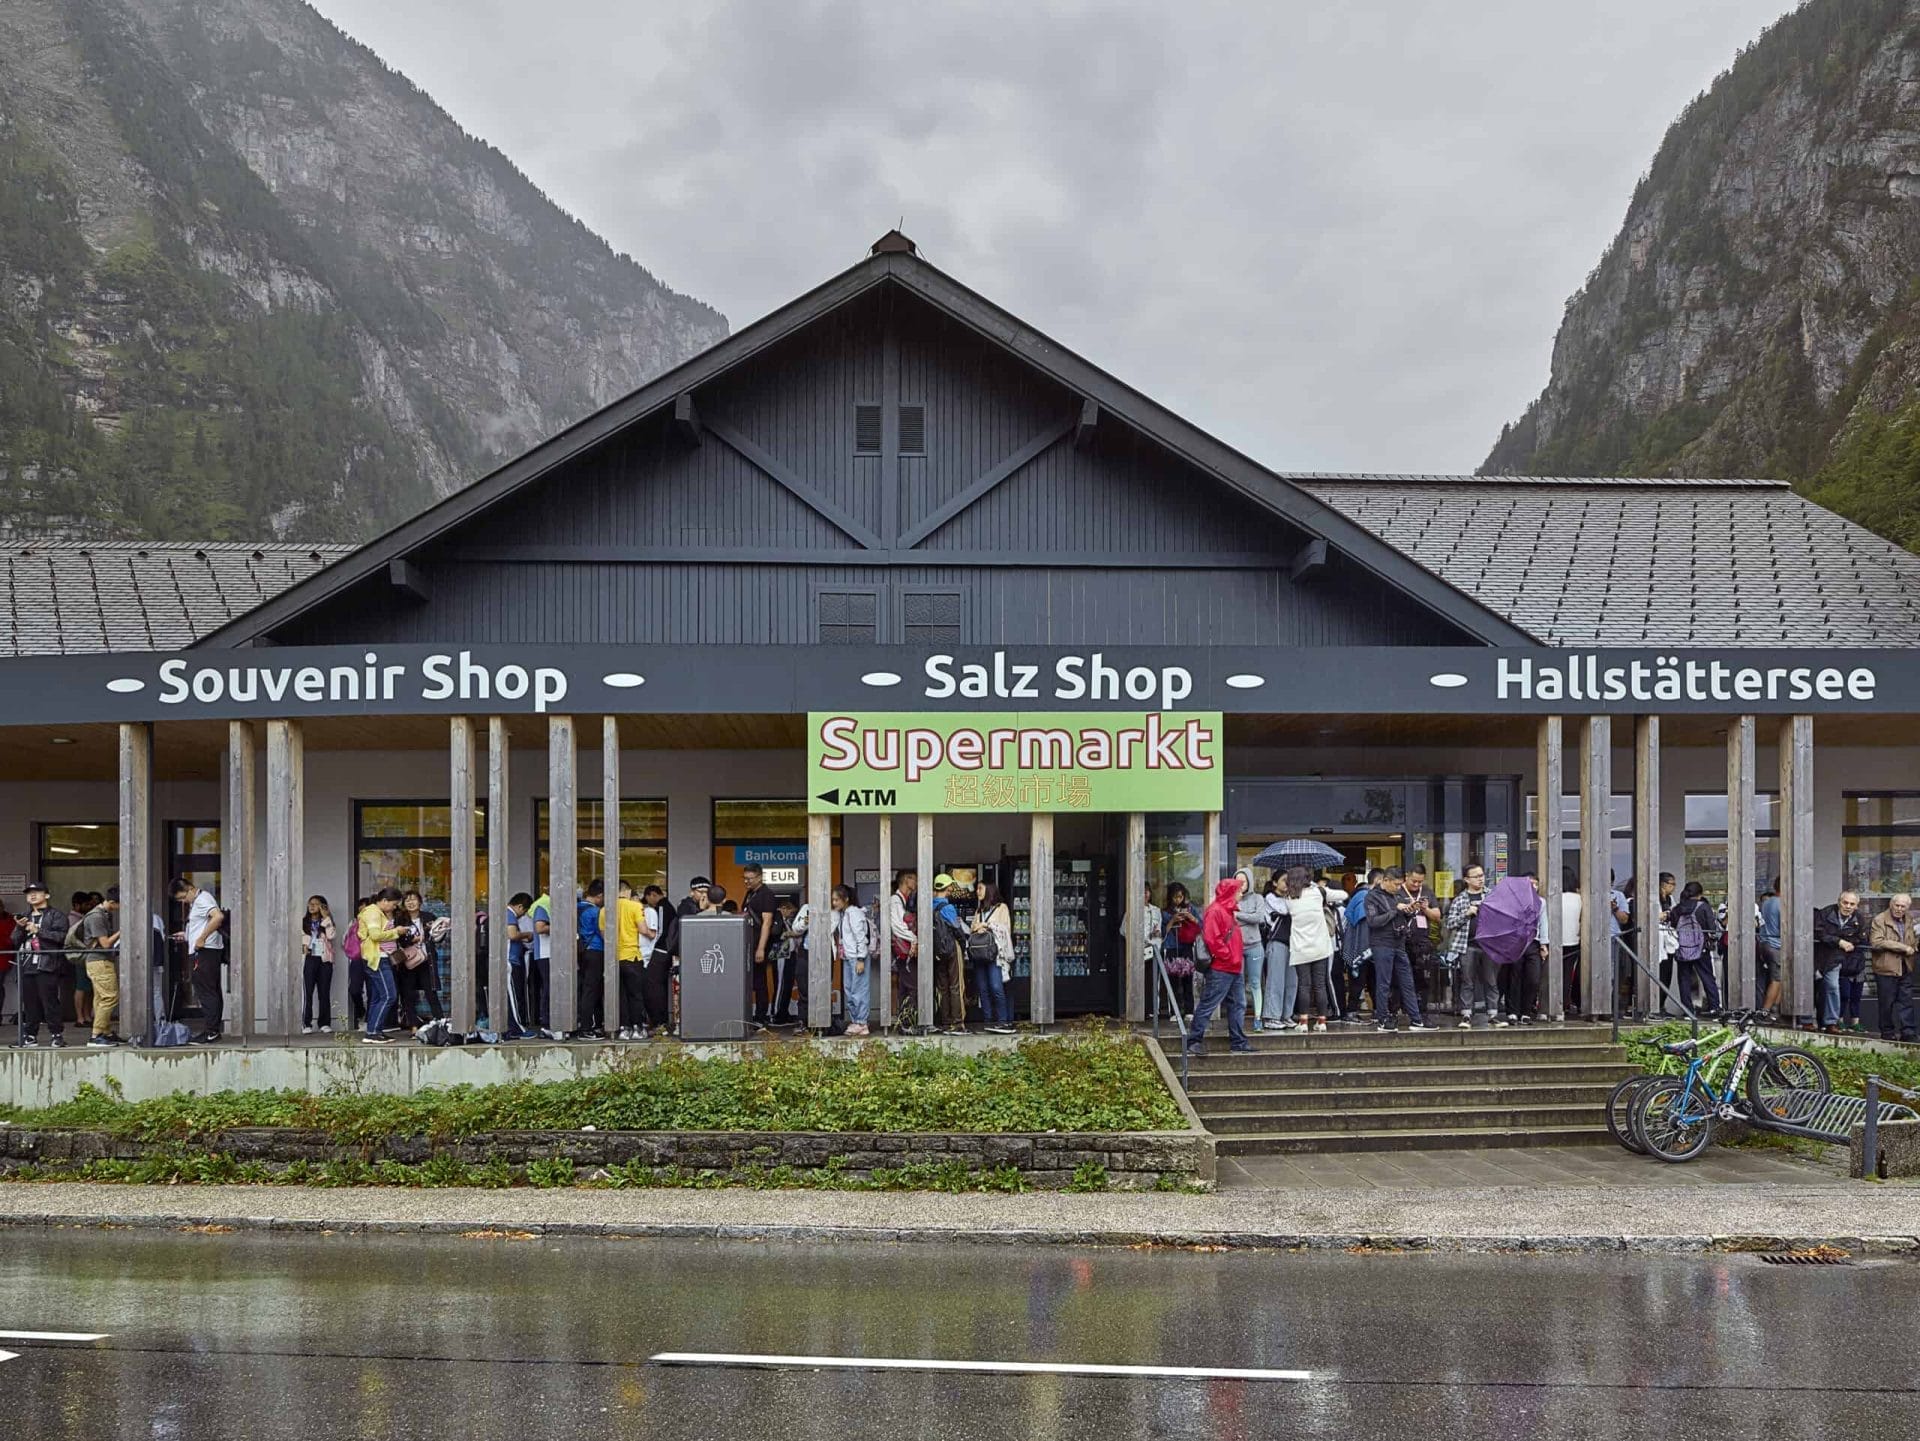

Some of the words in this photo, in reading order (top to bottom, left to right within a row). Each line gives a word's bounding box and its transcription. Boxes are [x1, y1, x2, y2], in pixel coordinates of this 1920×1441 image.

[158, 652, 405, 704] Souvenir
[421, 651, 568, 713] Shop
[924, 652, 1039, 699] Salz
[1054, 653, 1192, 710] Shop
[1497, 654, 1876, 701] Hallstättersee
[820, 713, 1214, 783] Supermarkt
[845, 789, 897, 806] ATM
[943, 773, 1094, 809] 超級市場
[771, 871, 795, 882] EUR
